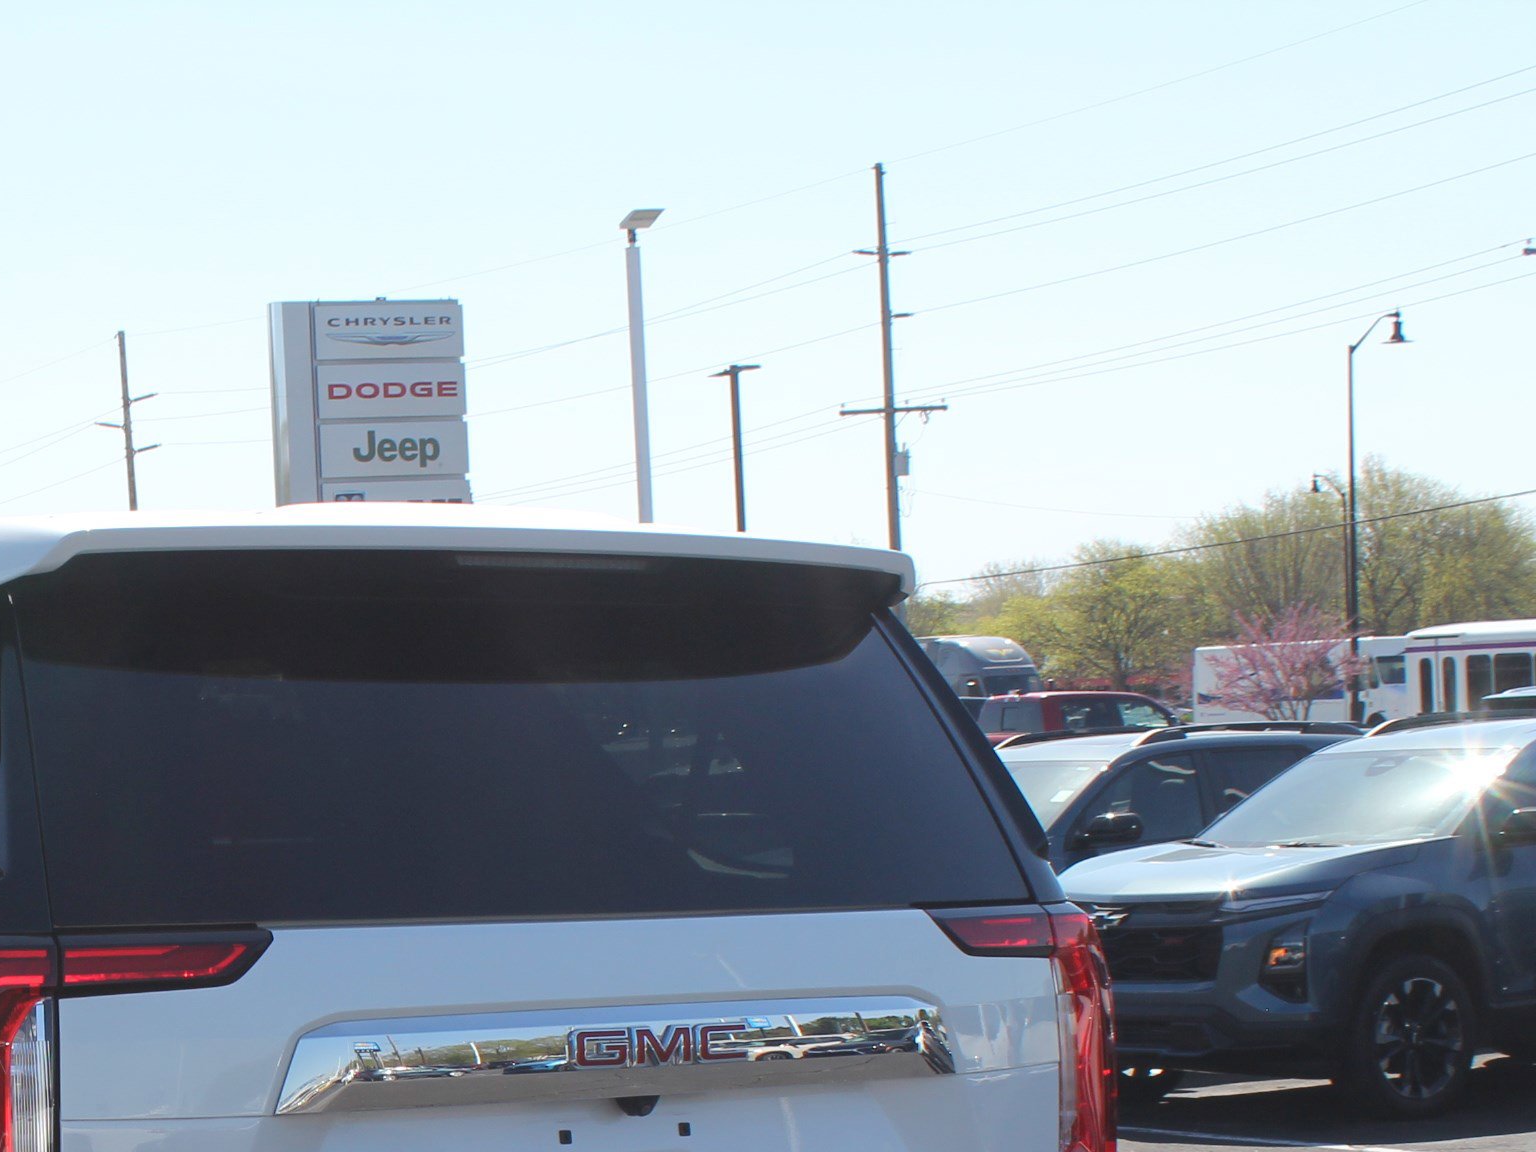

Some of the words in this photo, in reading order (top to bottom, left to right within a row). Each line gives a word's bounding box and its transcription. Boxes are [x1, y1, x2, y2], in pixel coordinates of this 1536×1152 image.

[327, 316, 452, 327] CHRYSLER
[327, 381, 459, 400] DODGE
[352, 430, 441, 468] Jeep
[567, 1023, 749, 1069] GMC
